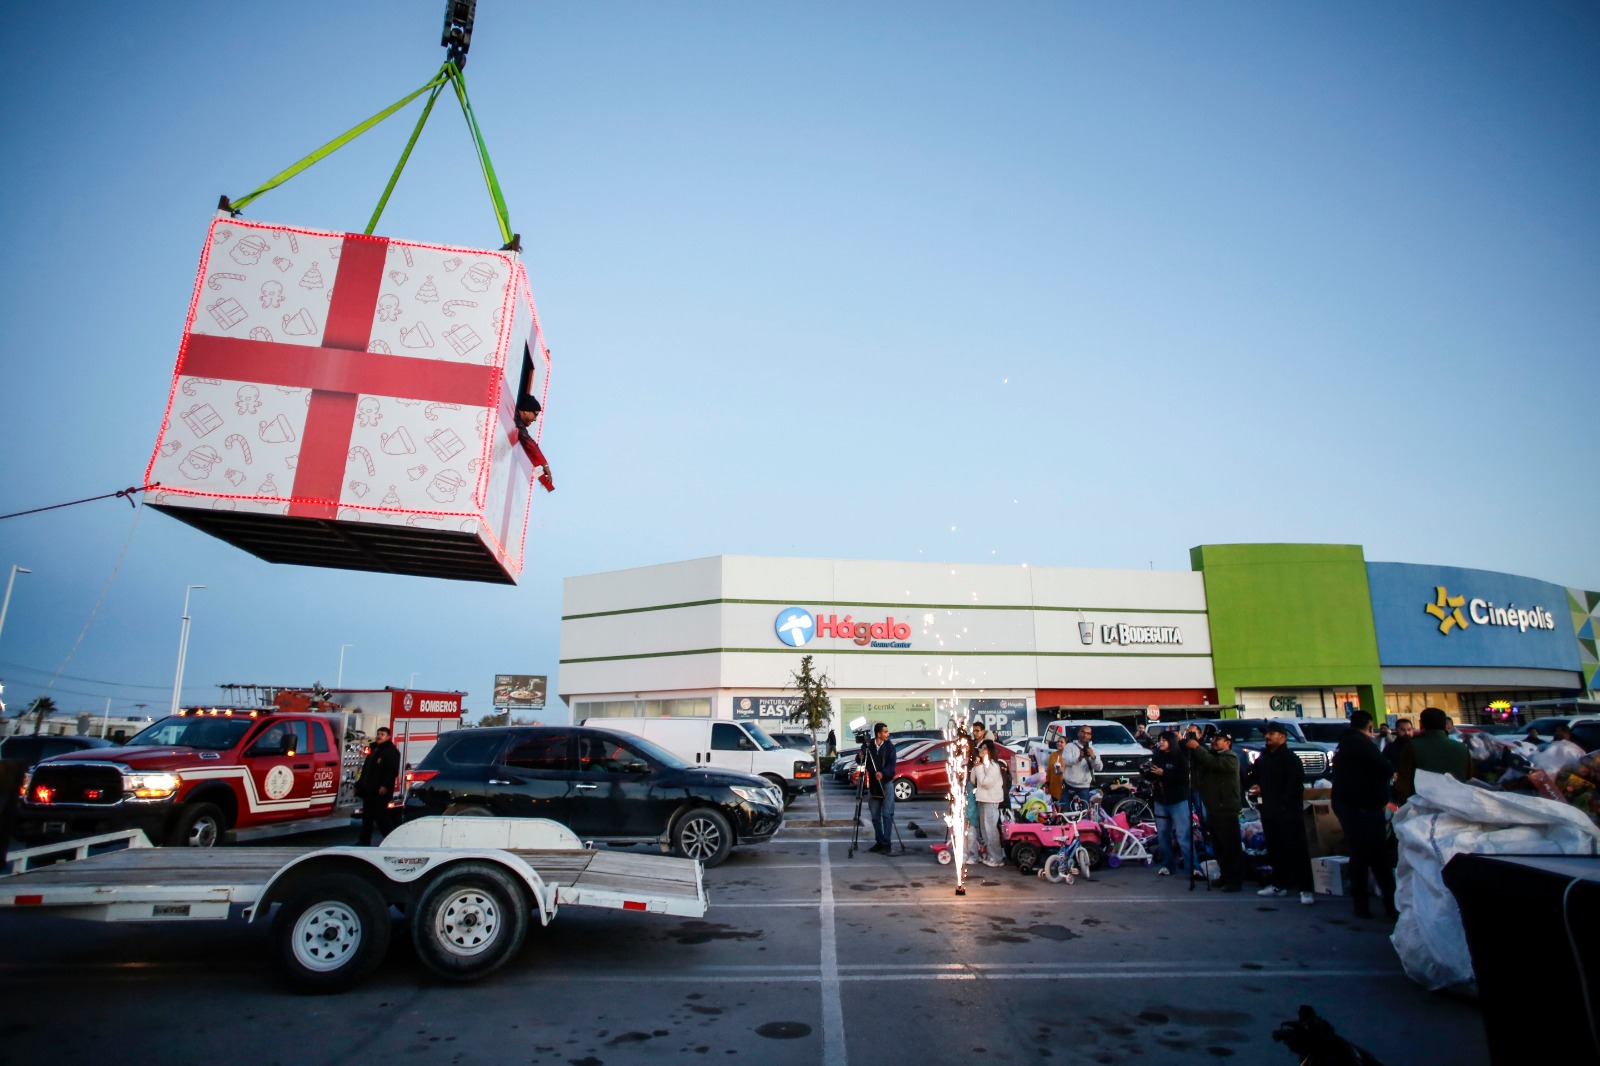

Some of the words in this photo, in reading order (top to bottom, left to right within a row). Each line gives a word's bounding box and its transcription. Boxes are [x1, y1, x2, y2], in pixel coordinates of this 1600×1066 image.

[1469, 598, 1555, 633] Cinépolis
[816, 614, 912, 646] Hágalo
[1116, 622, 1183, 646] BODEGUITA
[419, 699, 458, 713] BOMBEROS
